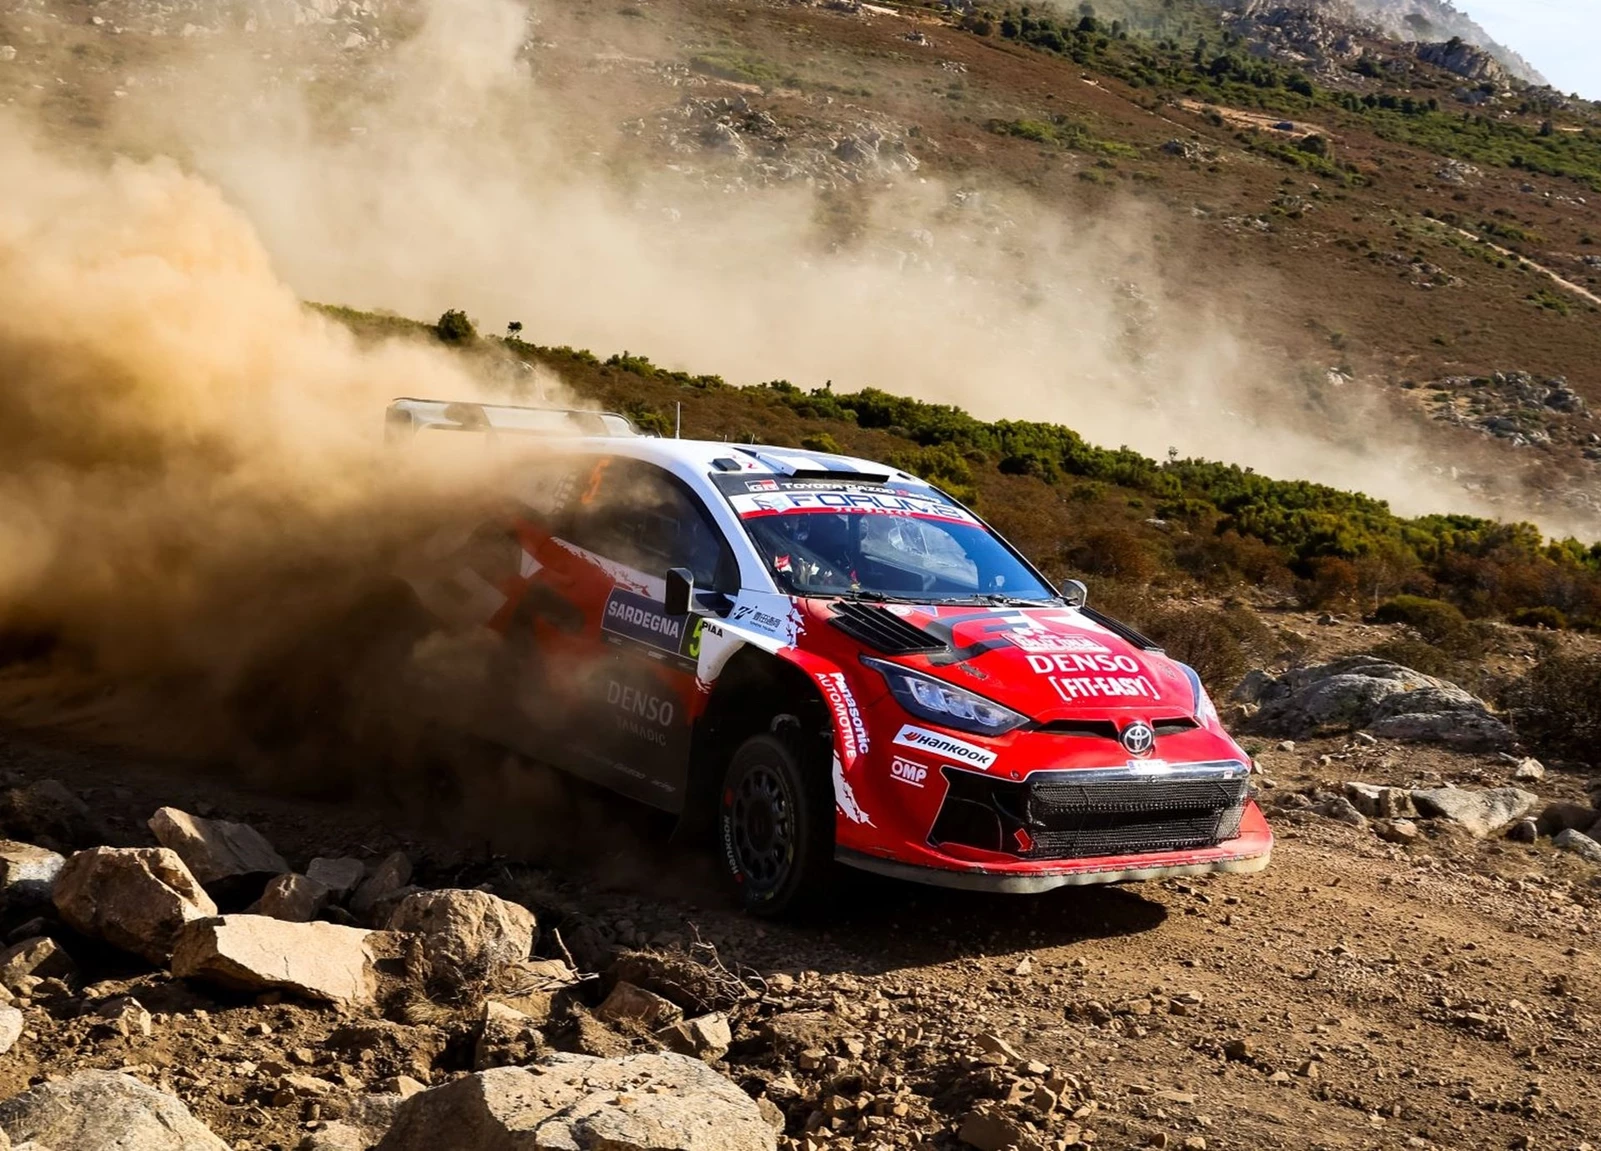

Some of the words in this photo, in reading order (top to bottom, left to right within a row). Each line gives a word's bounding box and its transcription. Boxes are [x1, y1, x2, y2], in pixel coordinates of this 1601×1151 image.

[781, 482, 847, 490] TOYOTA
[608, 601, 679, 639] SARDEGNA
[701, 621, 723, 638] PIAA
[1026, 654, 1139, 674] DENSO
[607, 680, 674, 727] DENSO
[815, 672, 857, 758] AUTOMOTIVE
[829, 672, 870, 754] Panasonic
[892, 760, 927, 783] OMP
